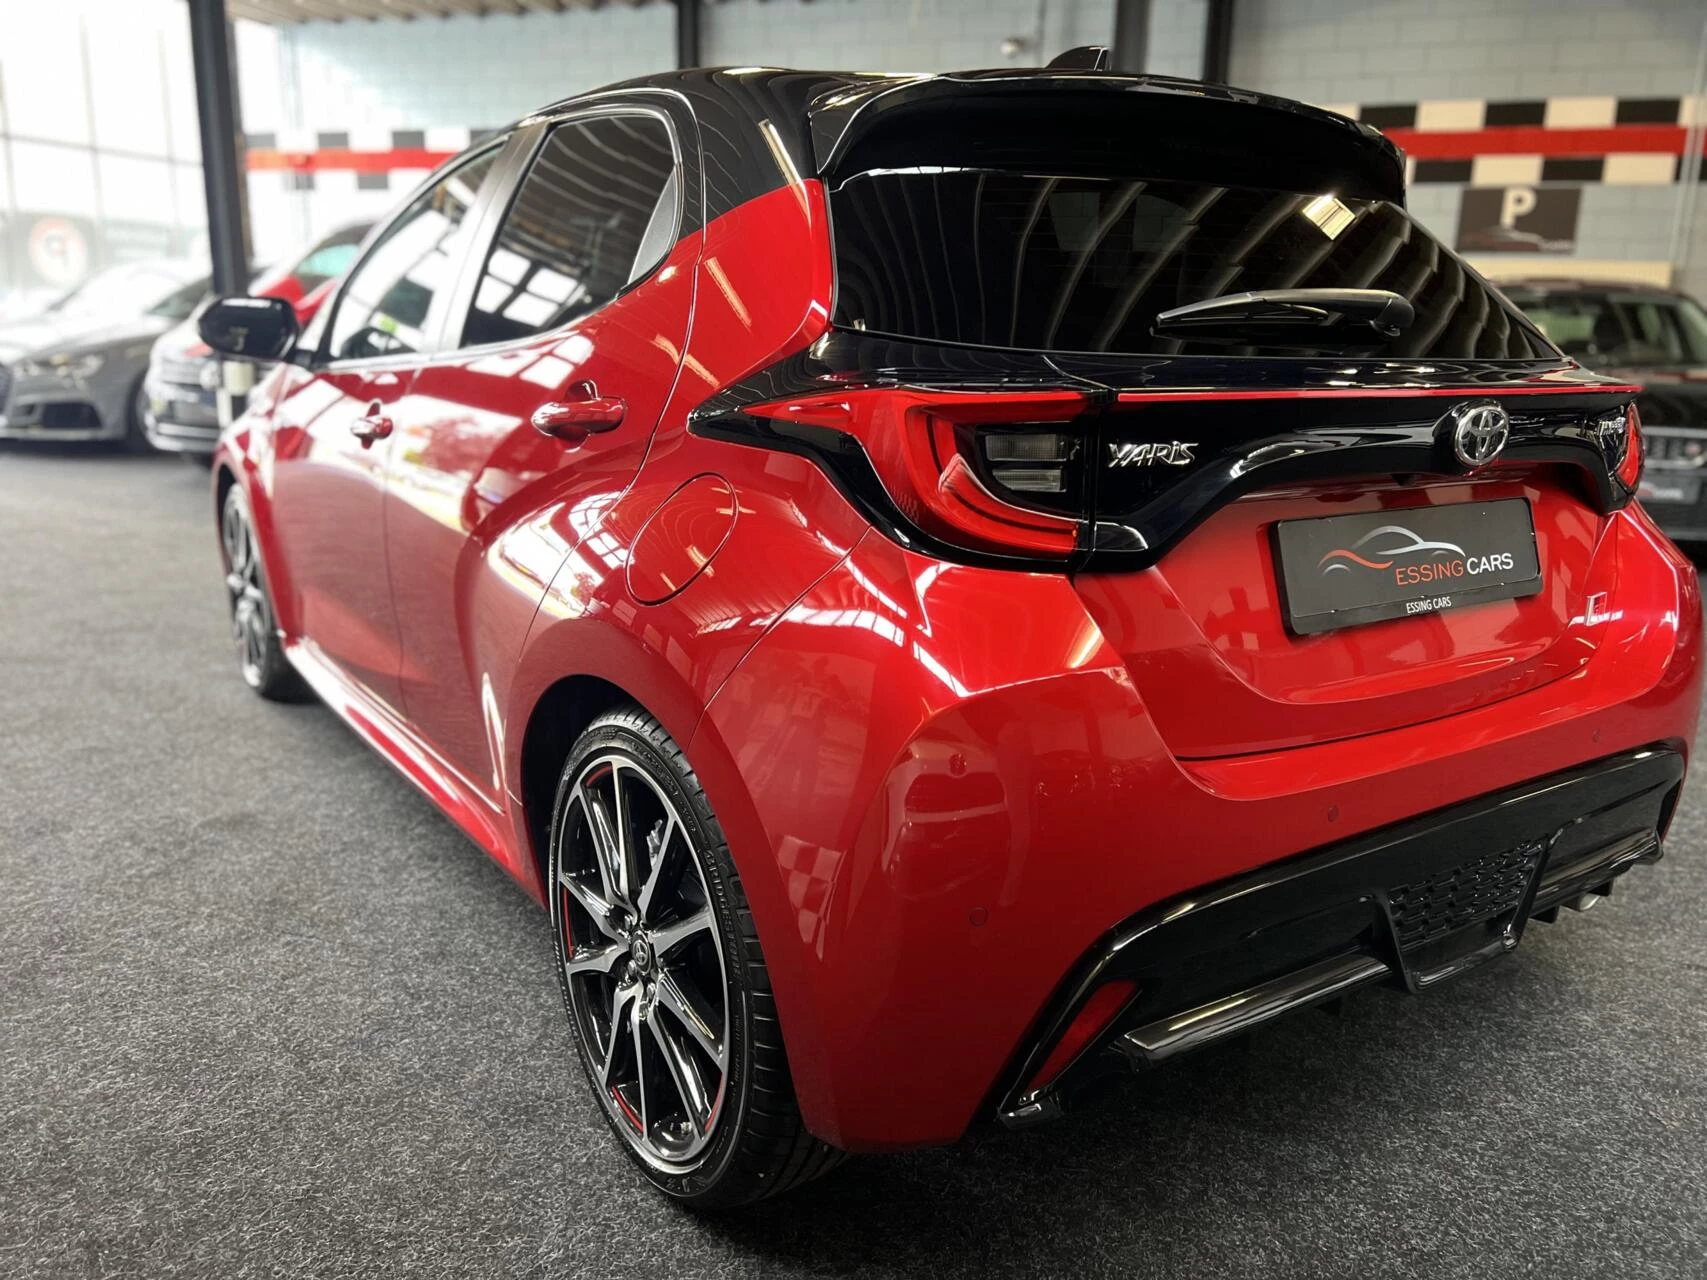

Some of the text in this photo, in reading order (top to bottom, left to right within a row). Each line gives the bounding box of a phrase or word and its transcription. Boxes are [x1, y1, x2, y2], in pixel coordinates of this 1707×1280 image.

[1502, 187, 1537, 229] P
[1108, 441, 1199, 467] YARIS
[1396, 553, 1514, 585] ESSING CARS
[1406, 596, 1452, 613] ESSING CARS
